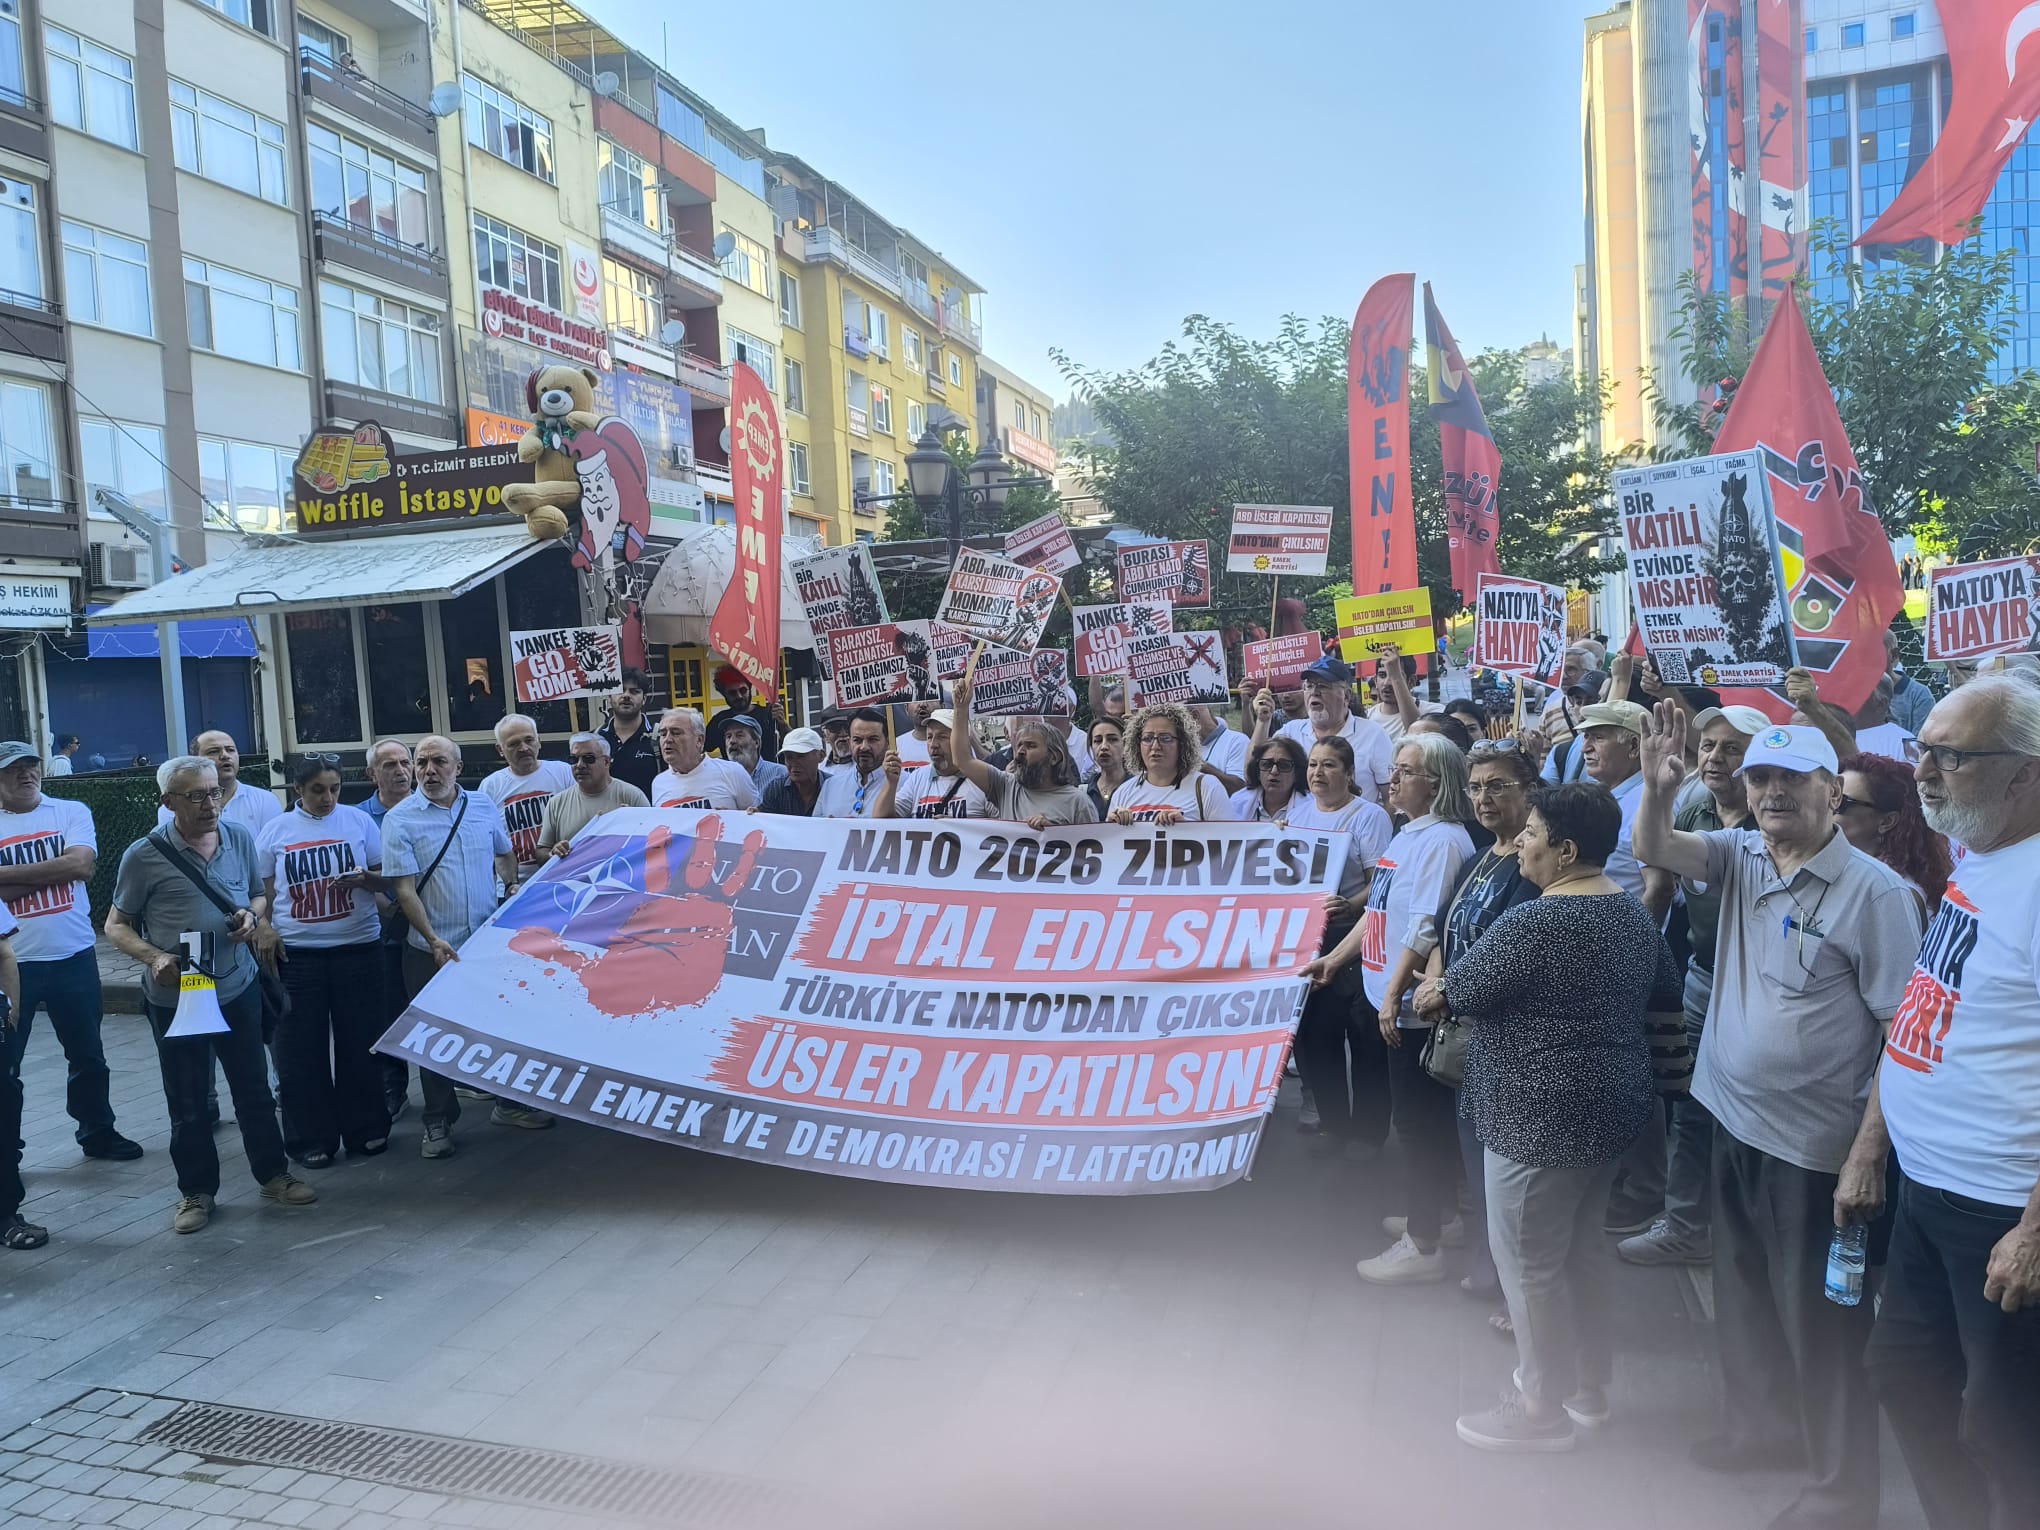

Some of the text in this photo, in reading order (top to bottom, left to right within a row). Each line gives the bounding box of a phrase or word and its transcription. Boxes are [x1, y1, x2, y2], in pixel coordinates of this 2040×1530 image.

[483, 289, 526, 322] BÜYÜK
[526, 305, 563, 335] BİRLİK
[1725, 458, 1746, 469] YAĞMA
[301, 491, 384, 525] Waffle
[1623, 489, 1655, 516] BİR
[1236, 510, 1328, 525] ABD ÜSLERİ KAPATILSIN
[1626, 503, 1701, 551] KATİLİ
[1234, 535, 1325, 552] NATO'DAN ÇIKILSIN!
[1722, 535, 1746, 545] NATO
[960, 556, 985, 574] ABD
[990, 564, 1024, 580] NATO'YA
[1123, 546, 1170, 567] BURASI
[1633, 552, 1695, 578] EVİNDE
[795, 569, 814, 584] BİR
[1124, 558, 1182, 583] ABD VE NATO
[13, 584, 58, 598] HEKİMİ
[799, 572, 842, 604] KATİLİ
[984, 578, 1021, 596] DURMAK
[1125, 573, 1182, 594] CUMHURİYETİ
[1638, 575, 1720, 609] MİSAFİR
[1937, 568, 2026, 611] NATO'YA
[806, 600, 841, 618] EVİNDE
[1077, 605, 1129, 631] YANKEE
[1352, 608, 1385, 621] NATO'DAN
[1484, 591, 1539, 621] NATO'YA
[1353, 619, 1416, 636] ÜSLER KAPATILSIN!
[1644, 613, 1683, 627] ETMEK
[1939, 598, 2031, 652] HAYIR
[515, 630, 569, 657] YANKEE
[833, 628, 885, 652] SARAYSIZ,
[1089, 625, 1123, 653] GO
[1484, 621, 1539, 664] HAYIR
[1647, 625, 1725, 644] İSTER MİSİN?
[528, 651, 565, 678] GO
[836, 641, 895, 668] SALTANATSIZ
[937, 660, 956, 674] ÜLKE
[1084, 647, 1127, 674] HOM
[1132, 648, 1183, 667] BAĞIMSIZ VE
[839, 658, 905, 685] TAM BAĞIMSIZ
[999, 662, 1032, 679] DURMAK
[1135, 657, 1187, 679] DEMOKRATİK
[1720, 669, 1742, 677] EMEK
[1744, 666, 1776, 677] PARTİSİ
[525, 670, 581, 700] HOME
[845, 678, 887, 700] BİR ÜLKE
[1138, 671, 1191, 693] TÜRKİYE
[1144, 686, 1193, 707] NATO DEFOL
[285, 843, 356, 884] NATO'YA
[837, 829, 1330, 886] NATO 2026 ZİRVESİ
[827, 884, 998, 969] İPTAL
[1013, 896, 1310, 972] EDİLSİN!
[779, 974, 942, 1027] TÜRKİYE
[948, 990, 1151, 1034] NATO'DAN
[746, 1022, 1285, 1117] ÜSLER KAPATILSIN!
[399, 1020, 1258, 1183] KOCAELİ EMEK VE DEMOKRASİ PLATFORMU
